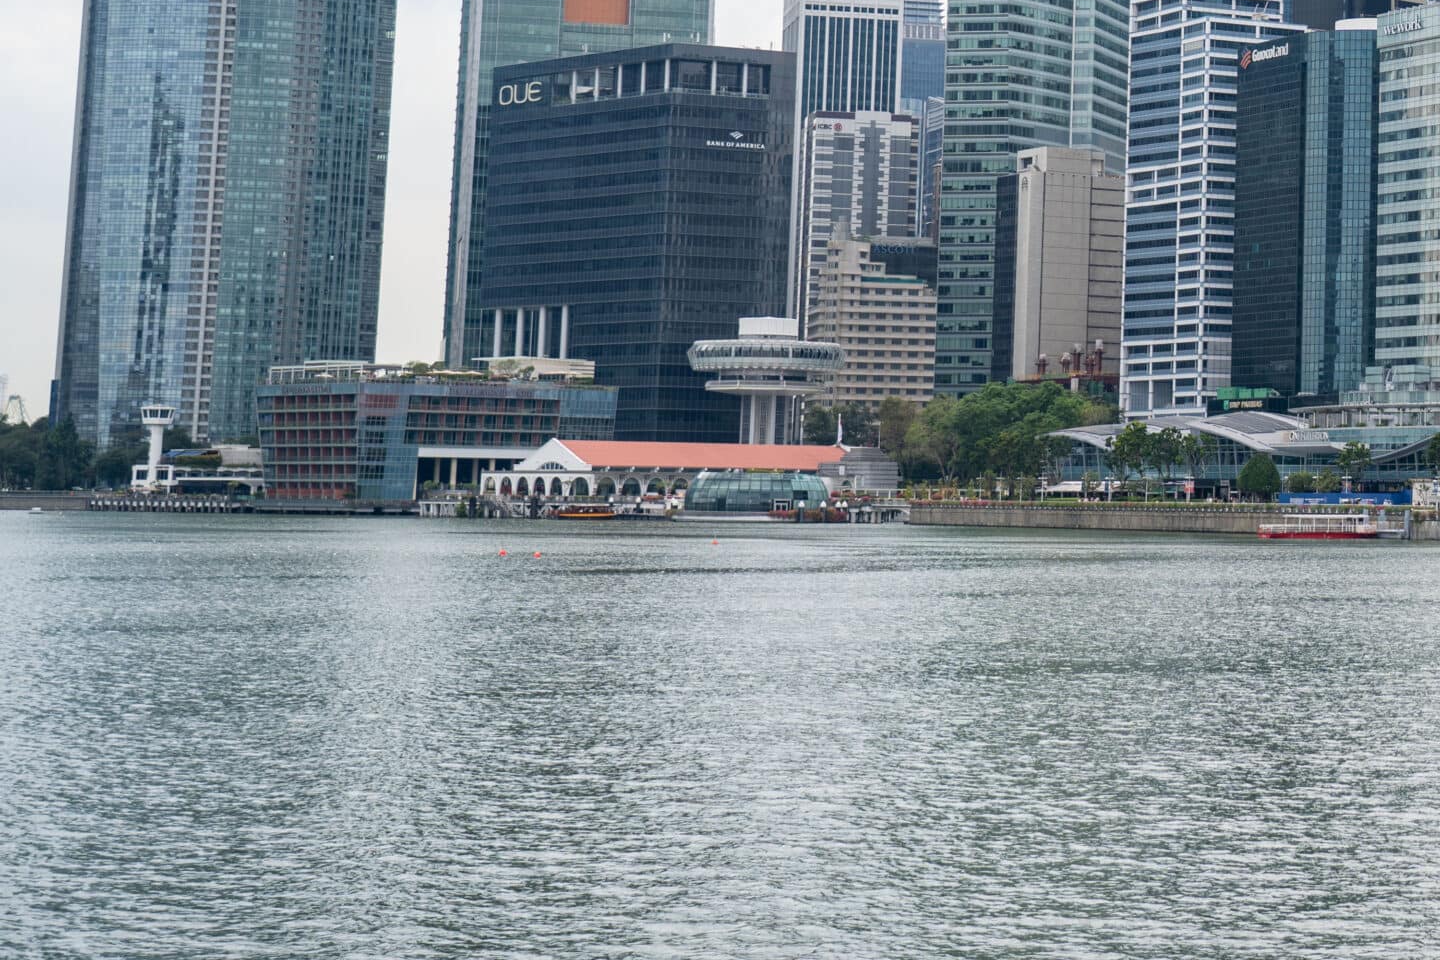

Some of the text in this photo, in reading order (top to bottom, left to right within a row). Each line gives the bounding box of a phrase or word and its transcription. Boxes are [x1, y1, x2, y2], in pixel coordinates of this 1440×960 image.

[1383, 17, 1421, 35] wework
[499, 81, 543, 106] OUE
[735, 141, 765, 149] AMERICA
